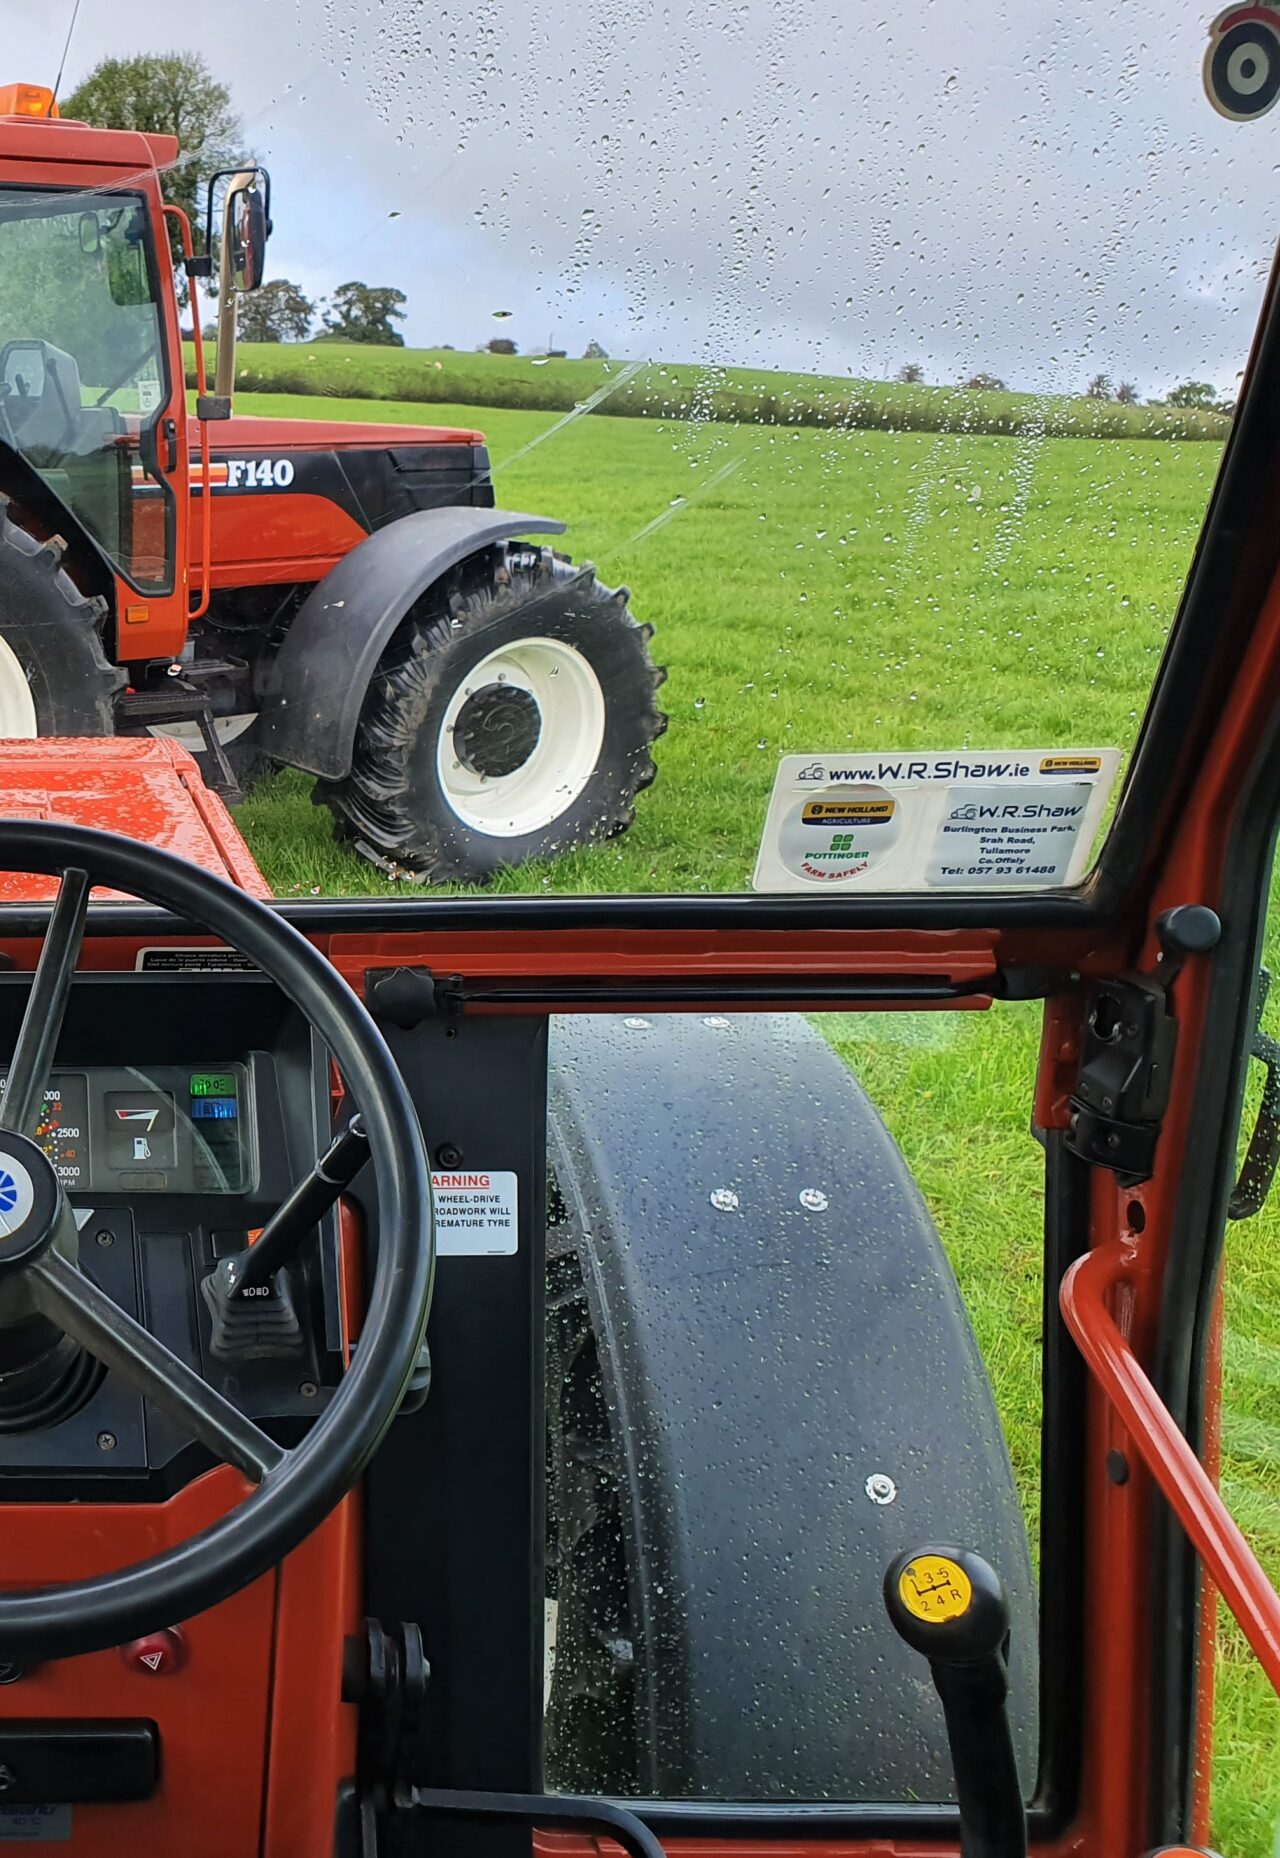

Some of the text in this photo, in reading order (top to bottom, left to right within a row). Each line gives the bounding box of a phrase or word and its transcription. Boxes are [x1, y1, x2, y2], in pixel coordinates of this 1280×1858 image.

[226, 459, 295, 488] F140
[829, 761, 1030, 780] www.W.R.Shaw.ie
[825, 805, 889, 814] NEW HOLLAND
[979, 804, 1083, 818] W.R.Shaw
[943, 825, 1076, 834] Burlington Business Park,
[979, 836, 1036, 845] Srah Road,
[979, 847, 1031, 855] Tullamore
[801, 861, 868, 879] FARM SAFELY
[940, 865, 1056, 875] Tel: 057 93 61488
[43, 1090, 61, 1101] 000
[57, 1128, 80, 1138] 2500
[57, 1166, 81, 1177] 3000
[431, 1174, 490, 1187] ARNING
[438, 1195, 501, 1203] WHEEL-DRIVE
[489, 1207, 511, 1215] WILL
[434, 1219, 510, 1227] REMATURE TYRE
[923, 1567, 949, 1584] 3 5
[920, 1588, 962, 1612] 2 4 R
